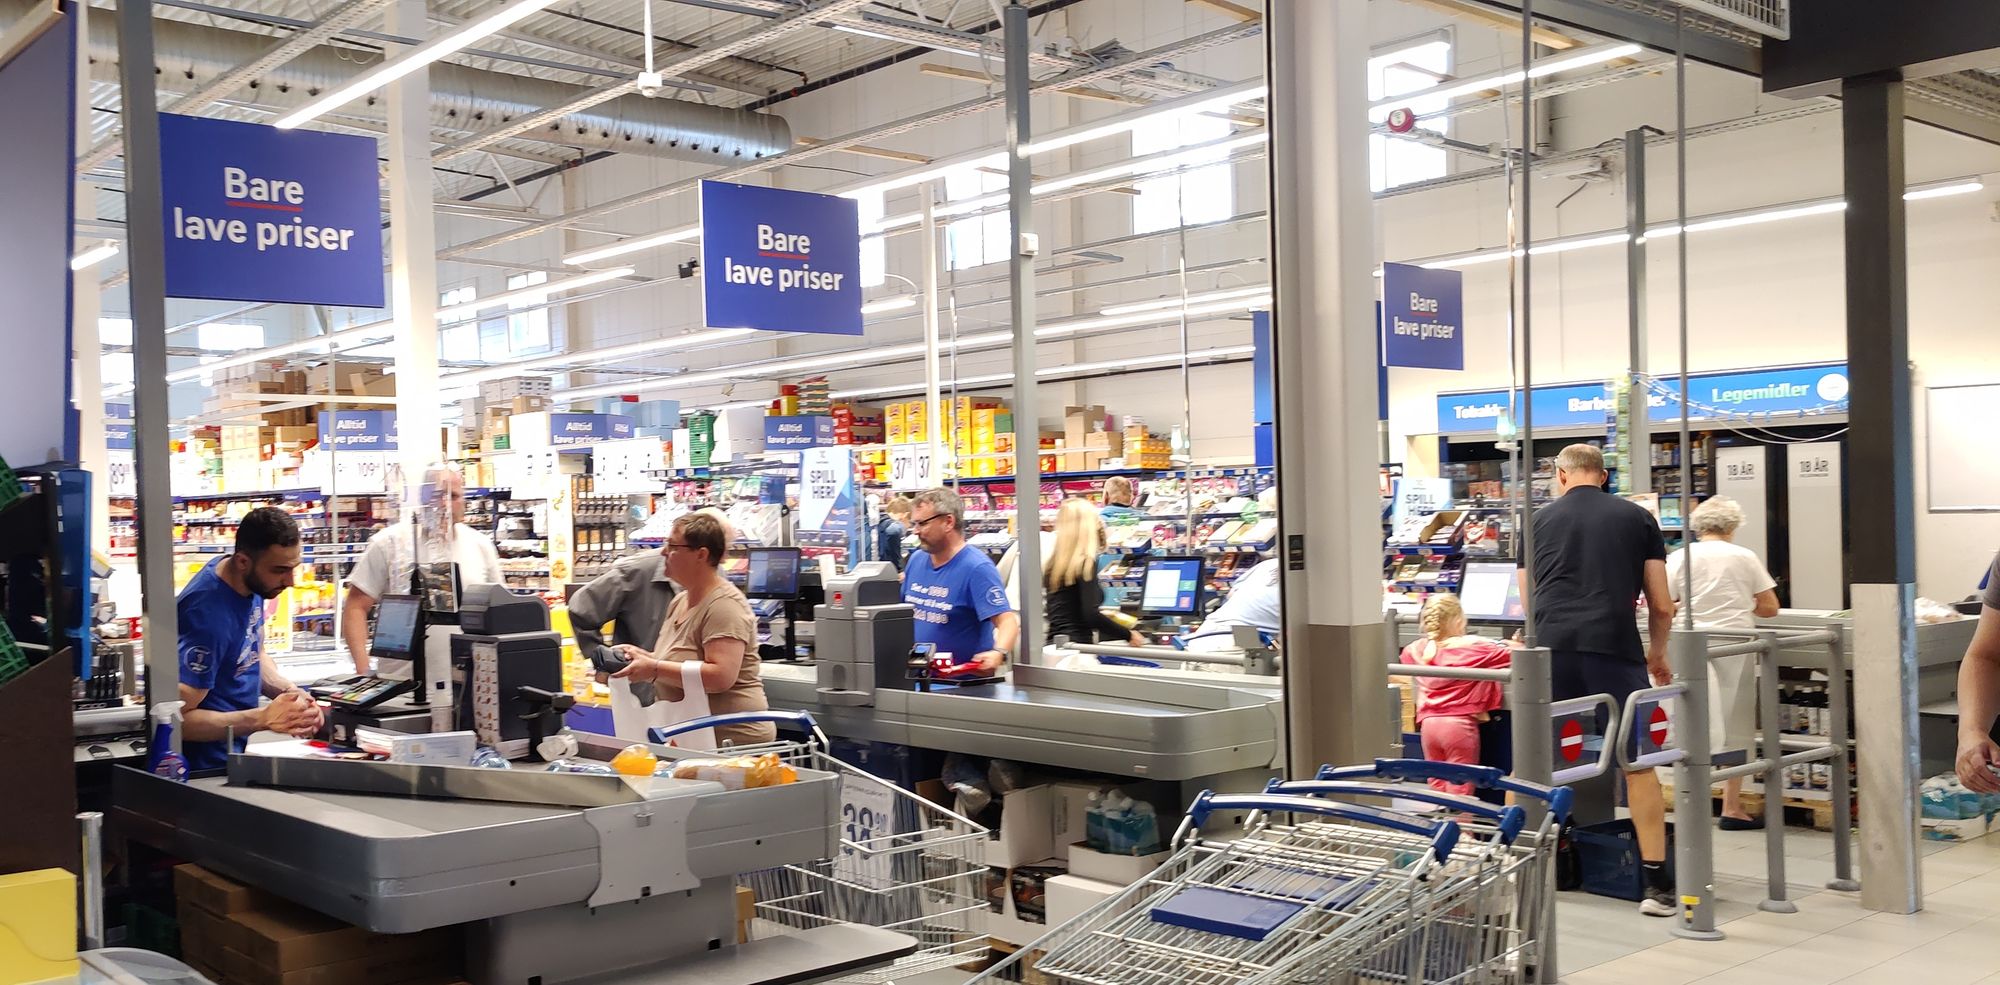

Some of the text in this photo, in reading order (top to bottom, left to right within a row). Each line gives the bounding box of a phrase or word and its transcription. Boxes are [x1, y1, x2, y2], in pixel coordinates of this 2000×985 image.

[224, 166, 304, 204] Bare
[174, 206, 354, 251] lave priser
[757, 224, 811, 254] Bare
[725, 257, 843, 292] lave priser
[1410, 292, 1438, 312] Bare
[1394, 316, 1455, 340] lave priser
[1711, 382, 1810, 404] Legemidler
[336, 419, 367, 430] Alltid
[565, 421, 593, 431] Alltid
[778, 423, 803, 433] Alltid
[347, 433, 379, 445] priser
[553, 435, 574, 444] lave
[767, 435, 786, 444] lave
[786, 435, 813, 445] priser
[810, 469, 837, 484] SPILL
